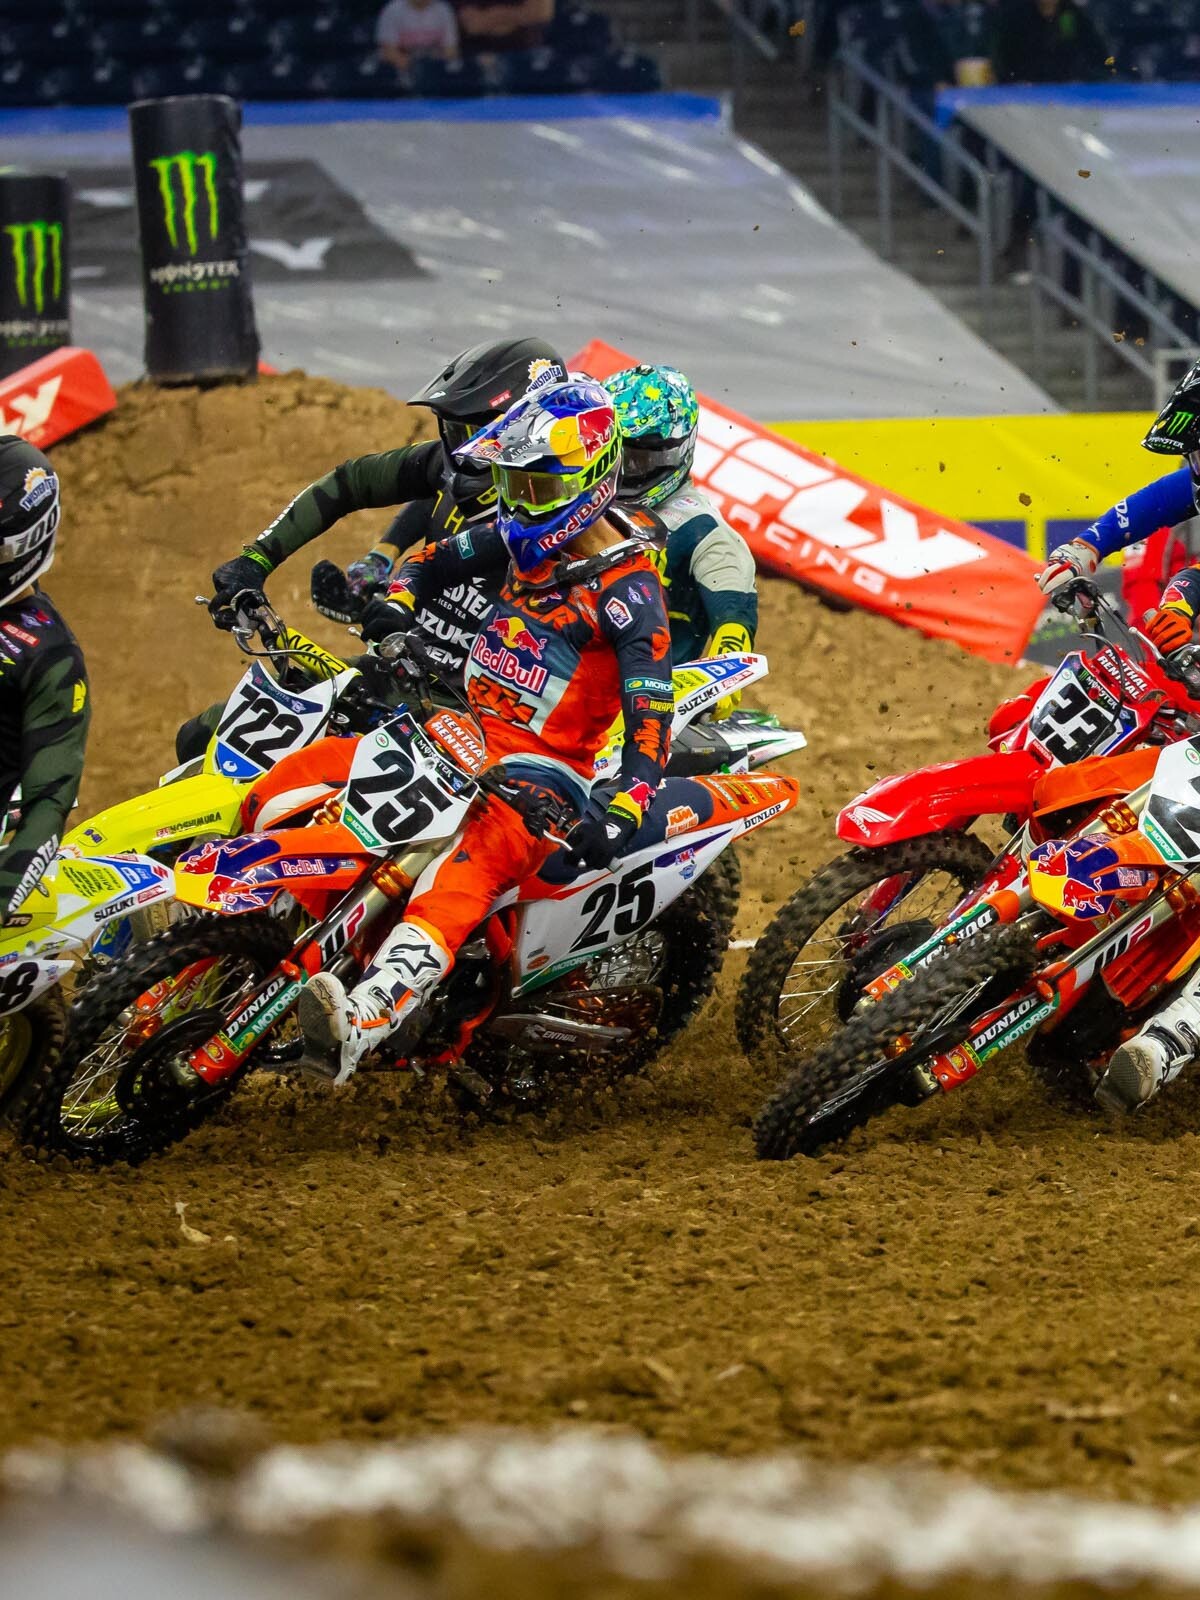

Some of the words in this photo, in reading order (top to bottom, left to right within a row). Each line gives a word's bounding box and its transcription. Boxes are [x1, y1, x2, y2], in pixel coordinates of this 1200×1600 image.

[538, 514, 582, 552] Red
[473, 634, 504, 672] Red
[499, 651, 549, 693] Bull
[677, 685, 720, 716] SUZUKI
[216, 683, 304, 771] 722
[346, 749, 454, 843] 25
[743, 803, 783, 830] DUNLOP
[844, 811, 872, 839] HONDA
[280, 859, 303, 876] Red
[302, 859, 326, 876] Bull
[94, 896, 136, 923] SUZUKI
[570, 860, 656, 951] 25
[997, 1003, 1058, 1050] MOTOREX
